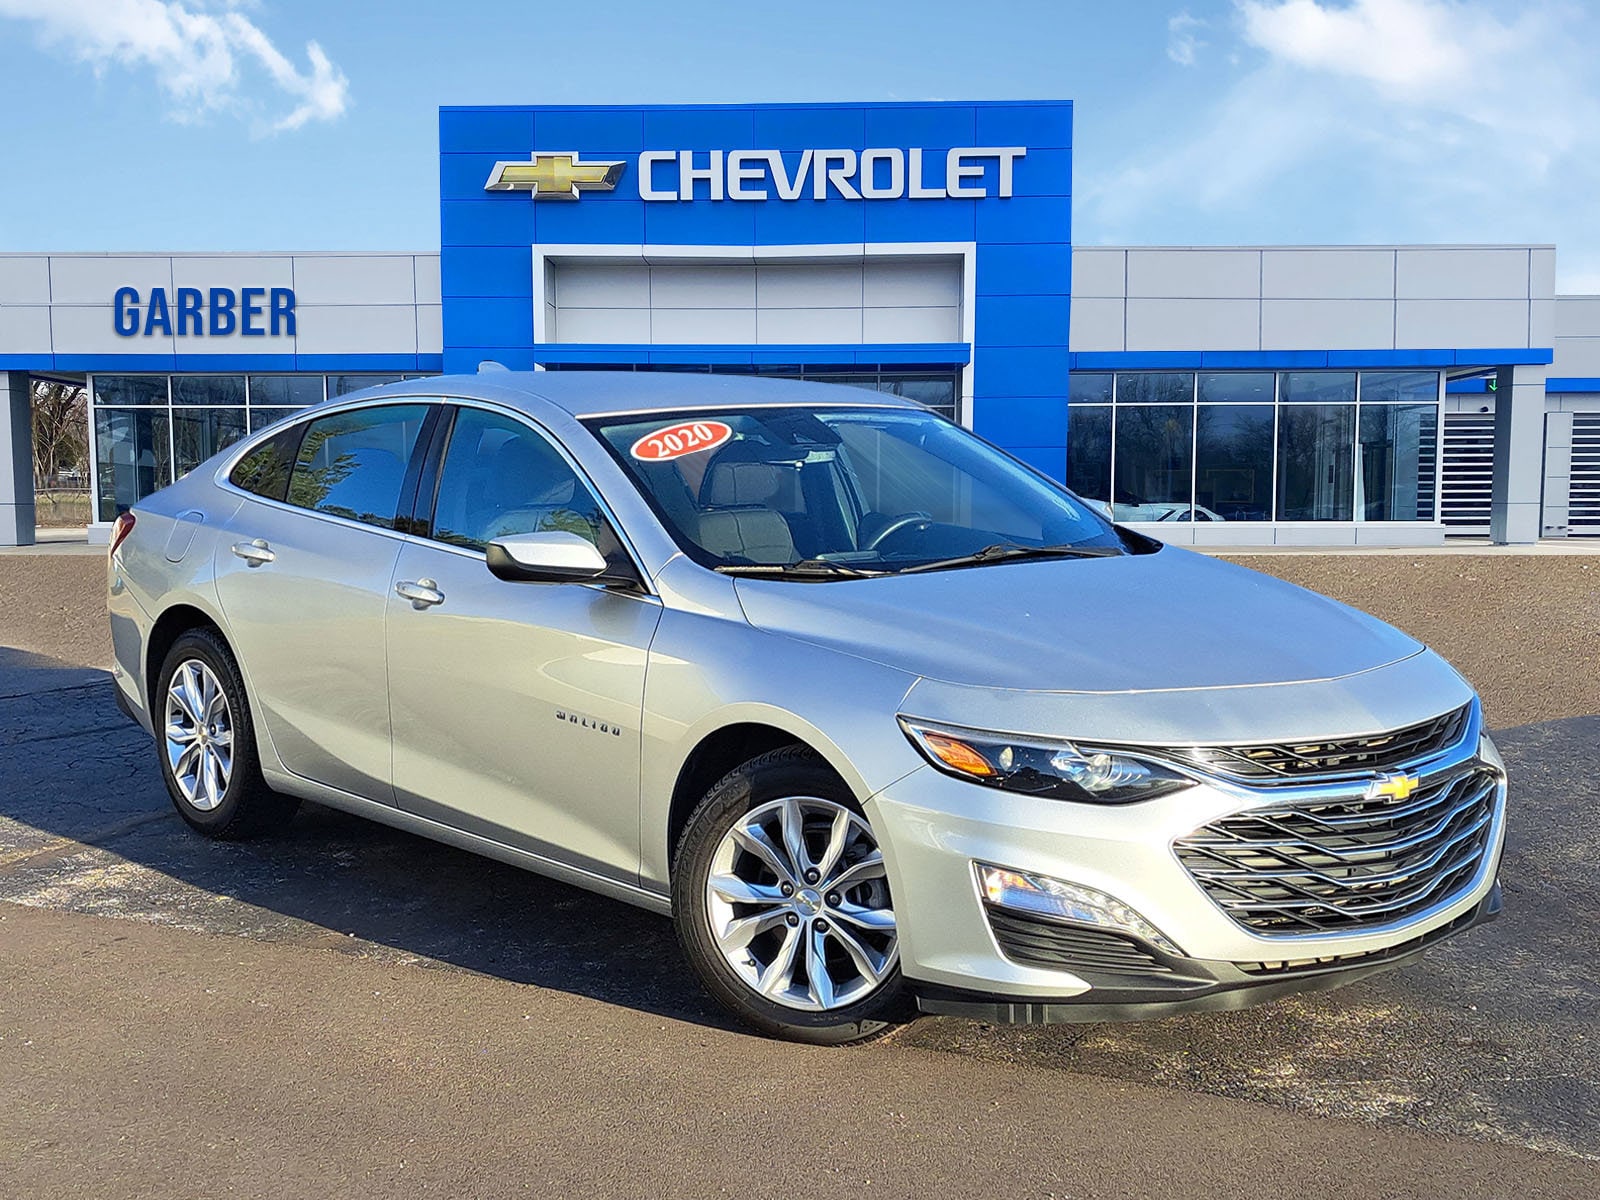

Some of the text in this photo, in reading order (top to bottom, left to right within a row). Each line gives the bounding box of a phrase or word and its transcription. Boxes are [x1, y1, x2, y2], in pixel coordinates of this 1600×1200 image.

[638, 146, 1027, 202] CHEVROLET
[114, 286, 297, 337] GARBER
[648, 424, 713, 457] 2020
[556, 710, 621, 736] MALIBU
